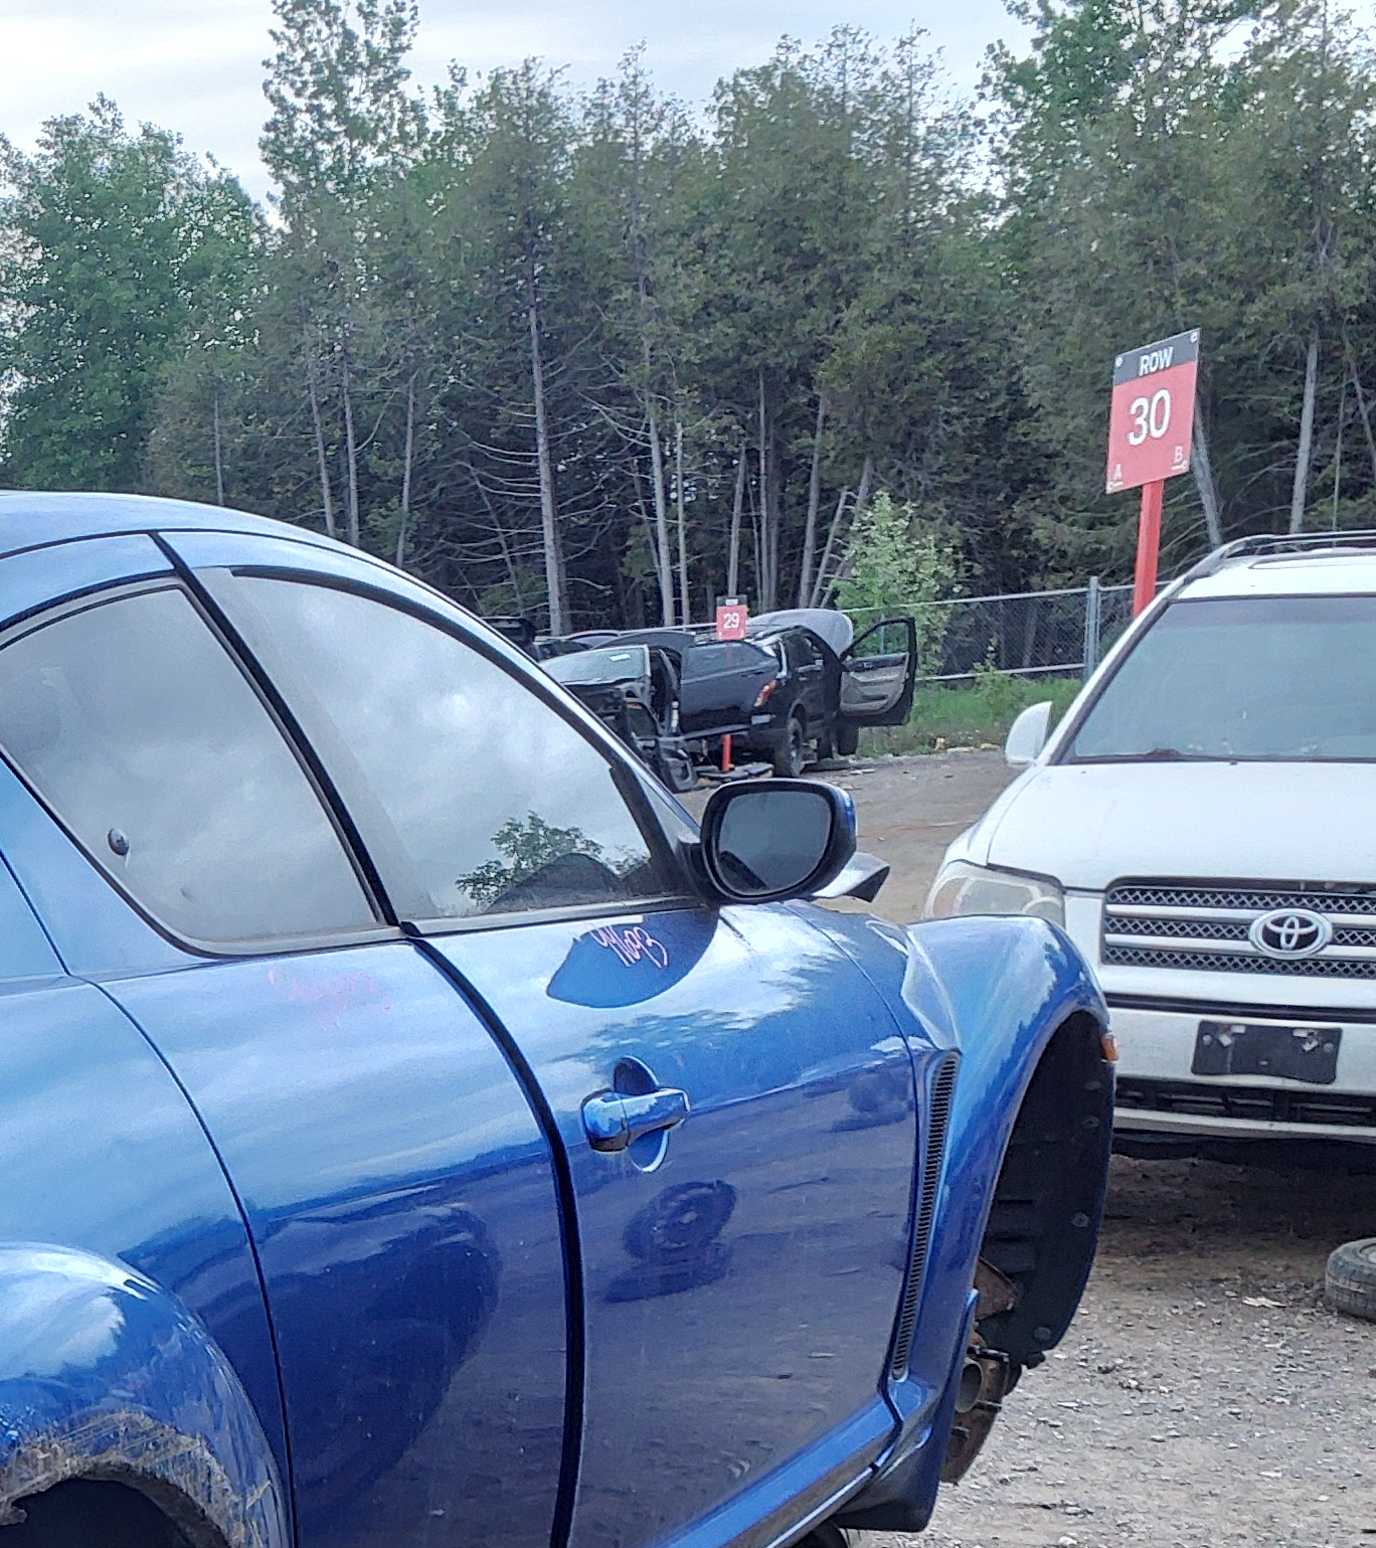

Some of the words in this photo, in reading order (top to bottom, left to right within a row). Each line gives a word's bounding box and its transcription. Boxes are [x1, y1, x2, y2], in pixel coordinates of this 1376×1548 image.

[1138, 346, 1174, 377] ROW
[1127, 388, 1172, 447] 30
[1173, 446, 1184, 463] B
[723, 612, 740, 629] 29
